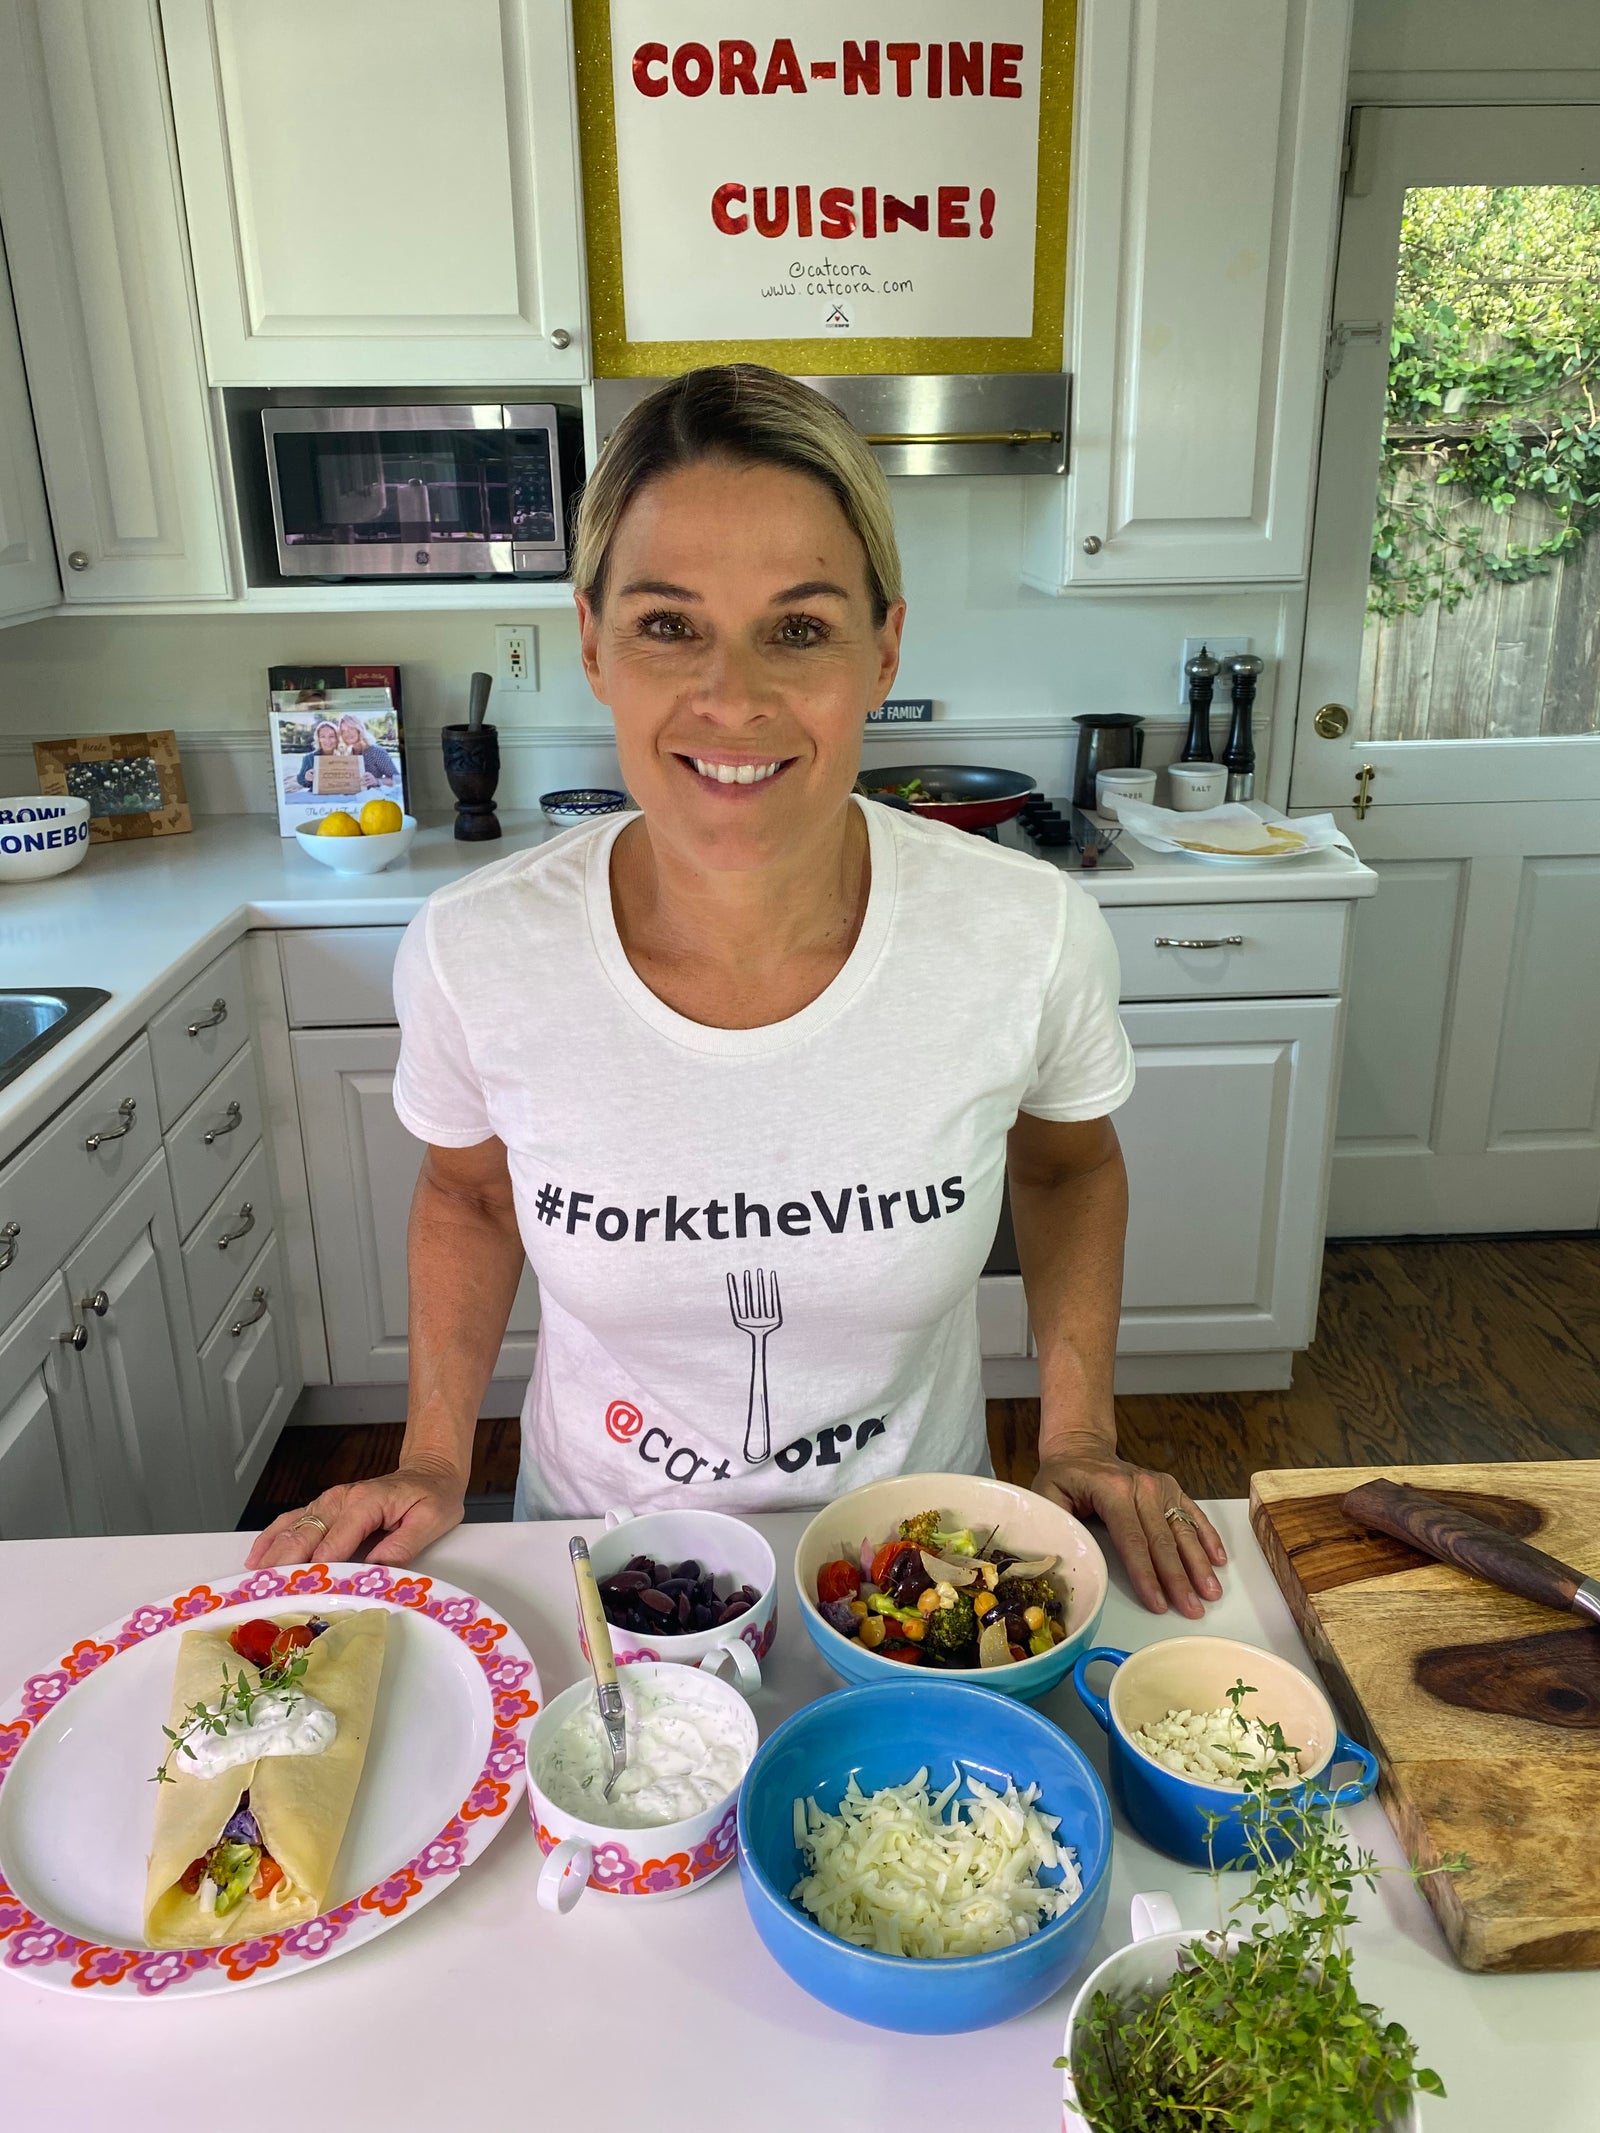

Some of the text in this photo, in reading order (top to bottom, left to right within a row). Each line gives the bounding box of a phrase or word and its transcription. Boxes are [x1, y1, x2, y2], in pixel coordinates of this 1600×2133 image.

[632, 38, 1024, 99] CORA-NTINE
[711, 182, 997, 240] CUISINE!
[789, 256, 872, 279] @catcora
[761, 279, 914, 298] www.catcora.com
[870, 705, 925, 720] OF FAMILY
[1191, 785, 1211, 793] SALT
[0, 821, 88, 854] ONEBO
[535, 1176, 966, 1242] #ForktheVirus
